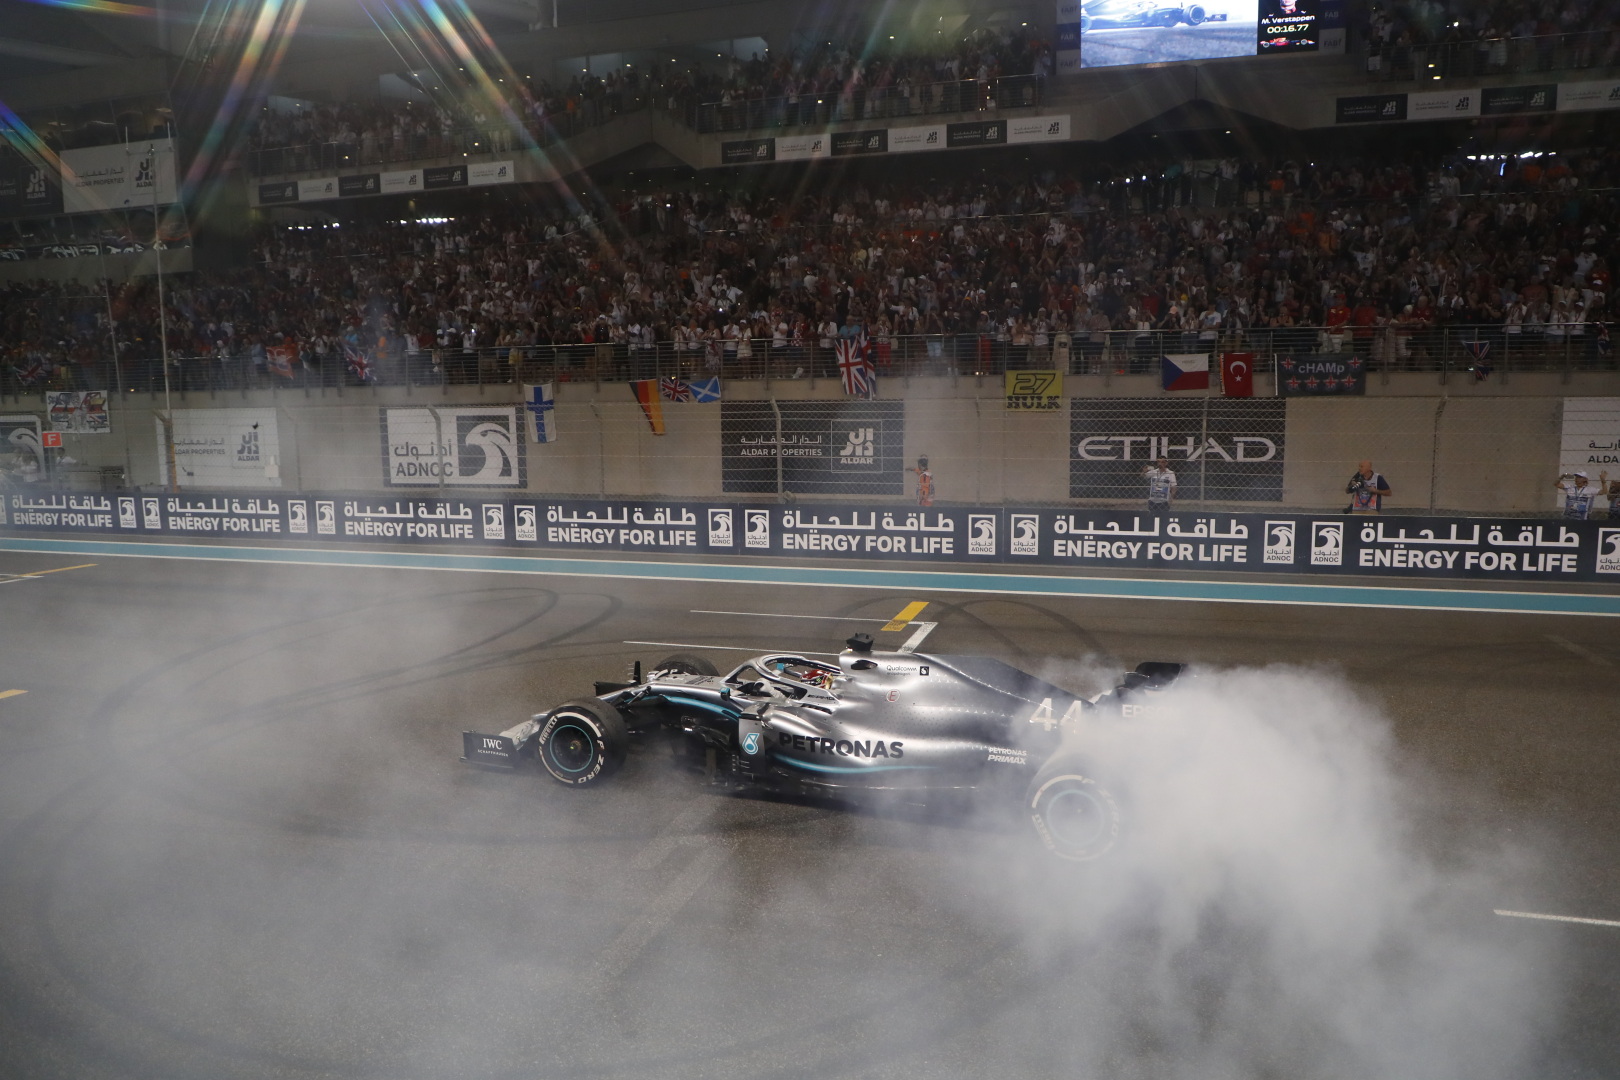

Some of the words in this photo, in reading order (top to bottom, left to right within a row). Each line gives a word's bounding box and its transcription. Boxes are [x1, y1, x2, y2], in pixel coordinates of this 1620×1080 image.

[1272, 15, 1316, 24] Verstappen
[1266, 23, 1309, 34] 00:16.77
[1012, 372, 1057, 395] 27
[1007, 395, 1061, 409] HULK
[48, 433, 57, 446] F
[740, 448, 768, 457] ALDAR
[771, 448, 822, 457] POPERTIES
[1077, 436, 1276, 462] ETIHAD
[1587, 455, 1619, 464] ALDA
[396, 462, 453, 477] ADNOC
[222, 517, 250, 532] FOR
[252, 518, 281, 533] LIFE
[882, 512, 955, 532] طاقة
[1166, 517, 1249, 540] طاقة
[406, 522, 439, 538] FOR
[440, 523, 474, 539] LIFE
[619, 528, 656, 545] FOR
[658, 529, 697, 546] LIFE
[1487, 525, 1580, 548] طاقة
[865, 535, 907, 553] FOR
[910, 536, 954, 555] LIFE
[1147, 542, 1194, 562] FOR
[1198, 544, 1248, 563] LIFE
[1464, 551, 1517, 571] FOR
[1522, 553, 1578, 573] LIFE
[886, 664, 918, 672] Qualcomm
[1029, 697, 1082, 734] 44
[483, 738, 503, 750] IWC
[779, 731, 904, 759] PETRONAS
[988, 746, 1027, 756] PETRONAS
[987, 754, 1026, 765] PRIMAX
